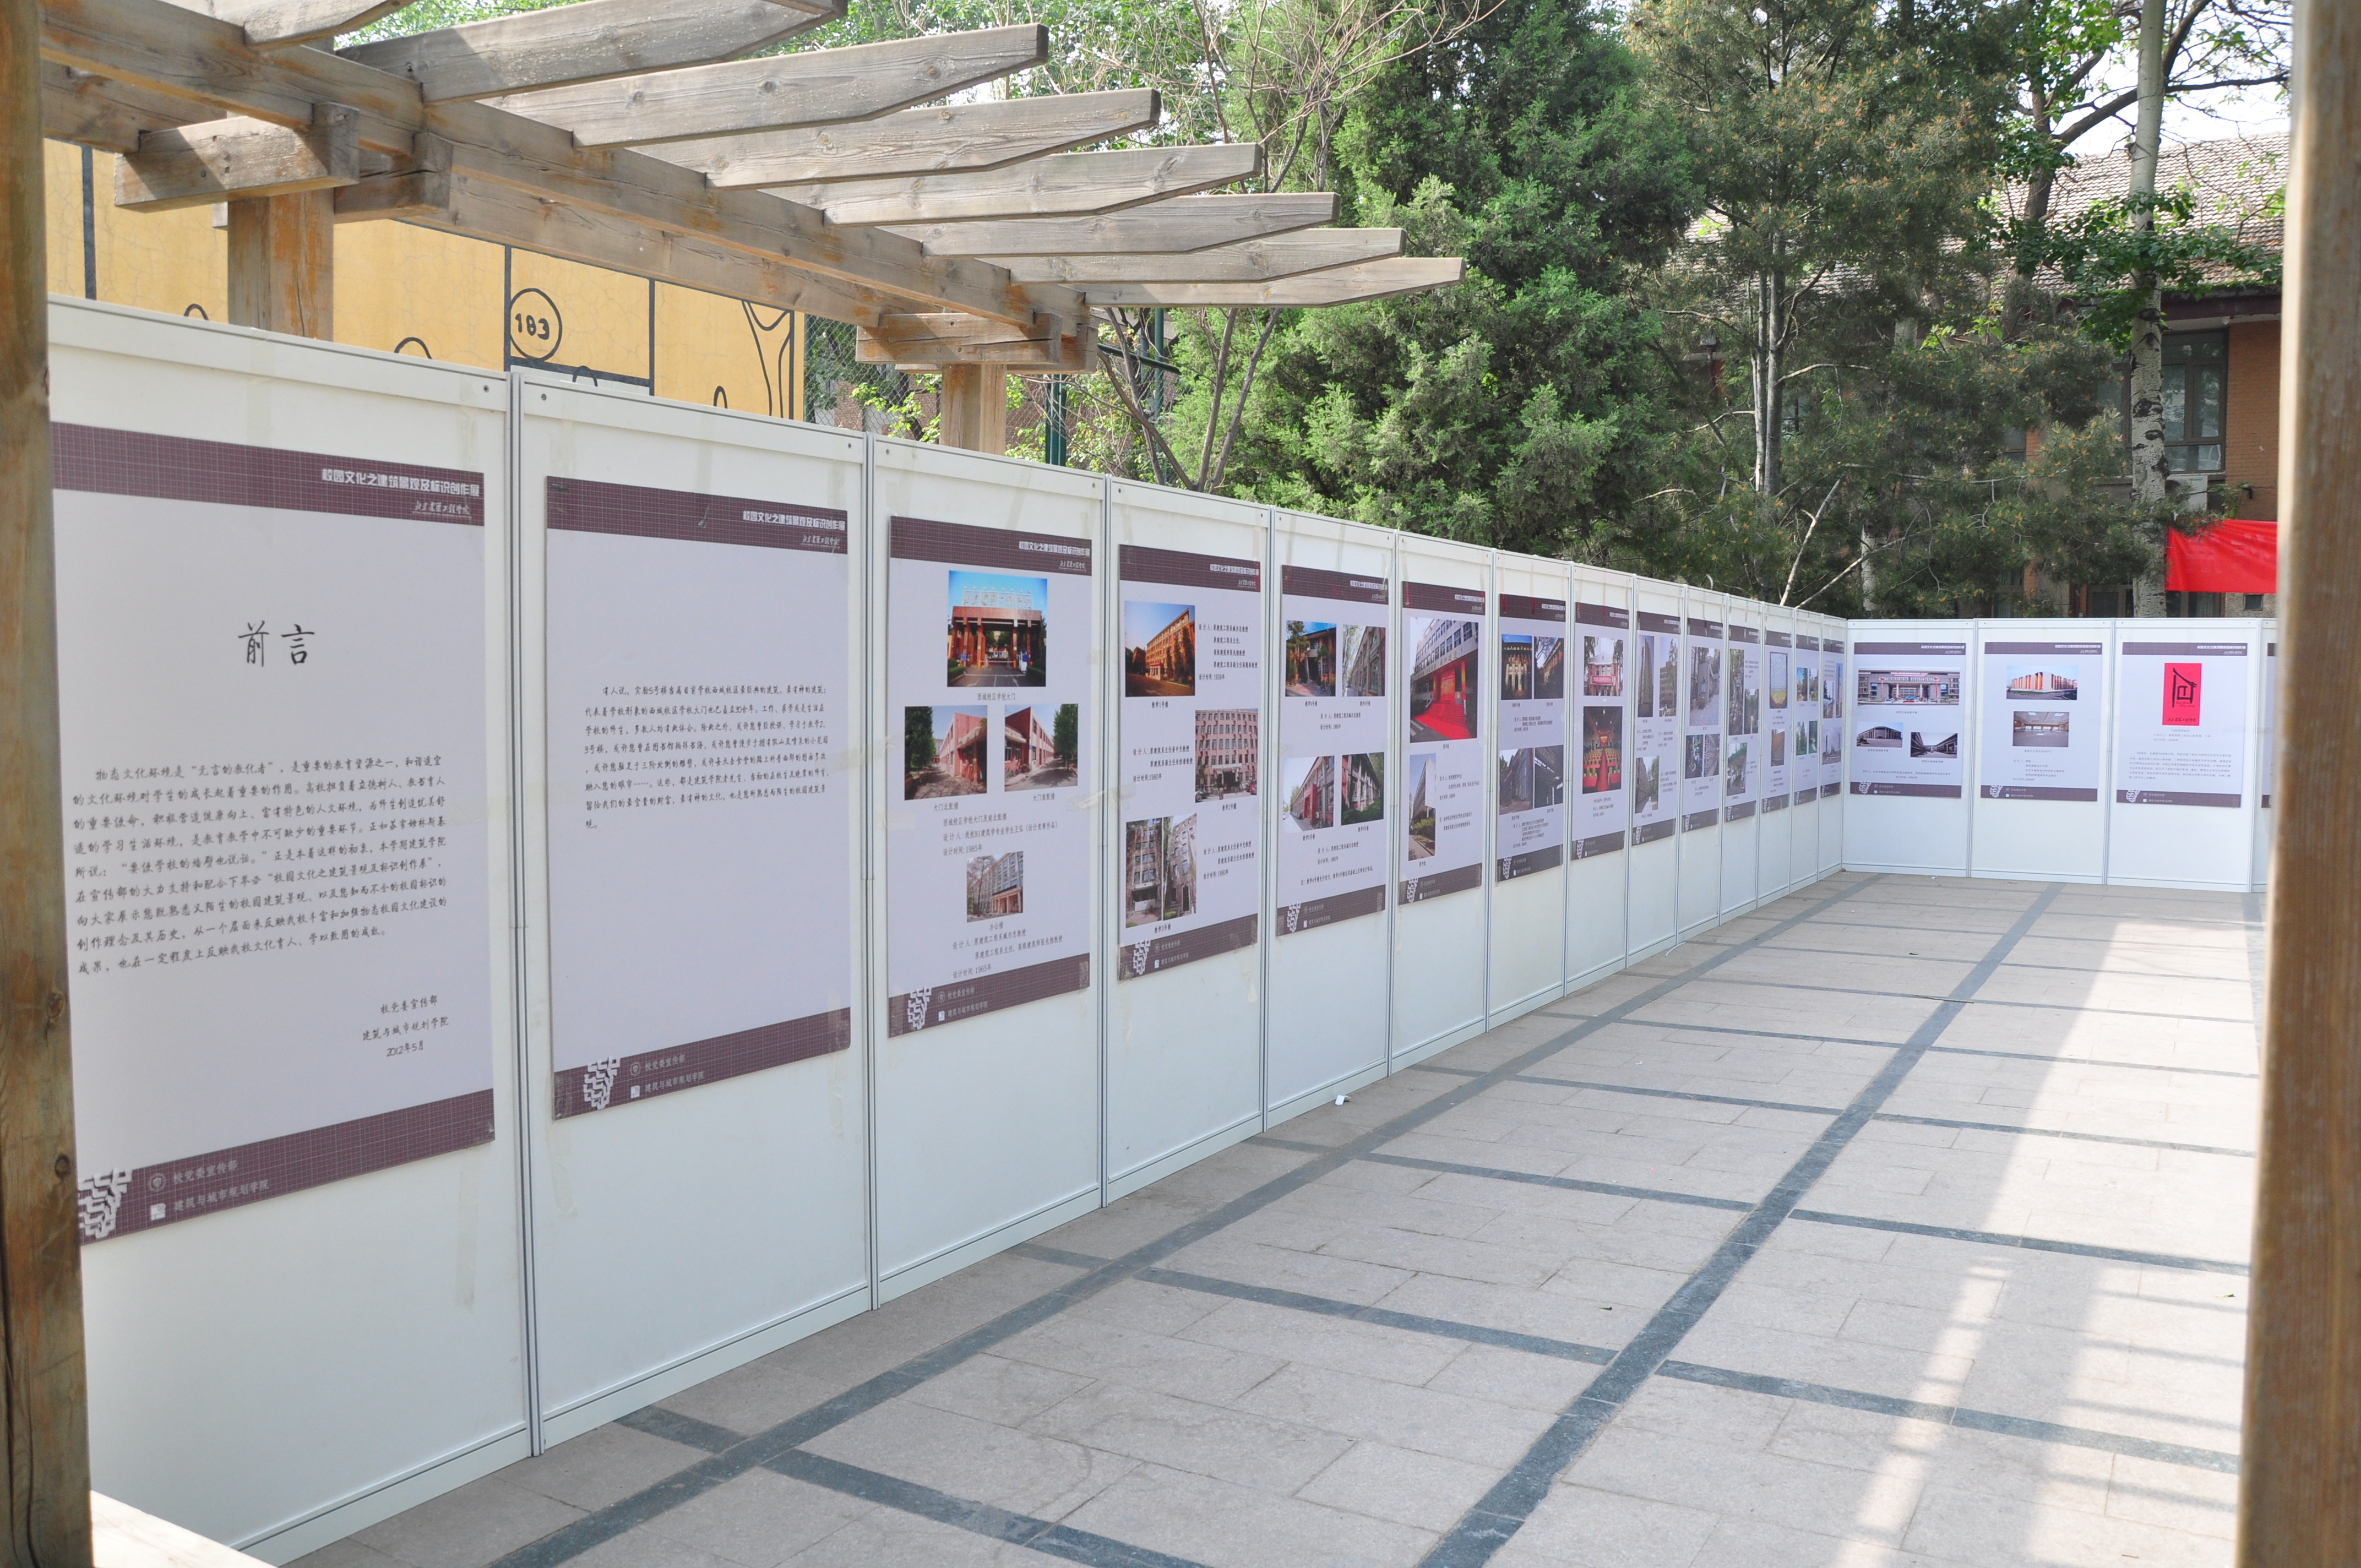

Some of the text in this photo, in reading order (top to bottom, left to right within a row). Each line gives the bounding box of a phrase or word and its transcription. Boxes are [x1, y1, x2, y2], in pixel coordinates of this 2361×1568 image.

[515, 313, 550, 340] 183
[322, 469, 480, 497] 校园文化之建筑景观及标识创作展
[743, 511, 845, 531] 校园文化之建筑景观及标识创作展
[238, 620, 315, 667] 前言
[380, 995, 438, 1014] 校党委宣传部
[363, 1016, 449, 1041] 建筑与城市规划学院
[387, 1040, 423, 1057] 2012年5月
